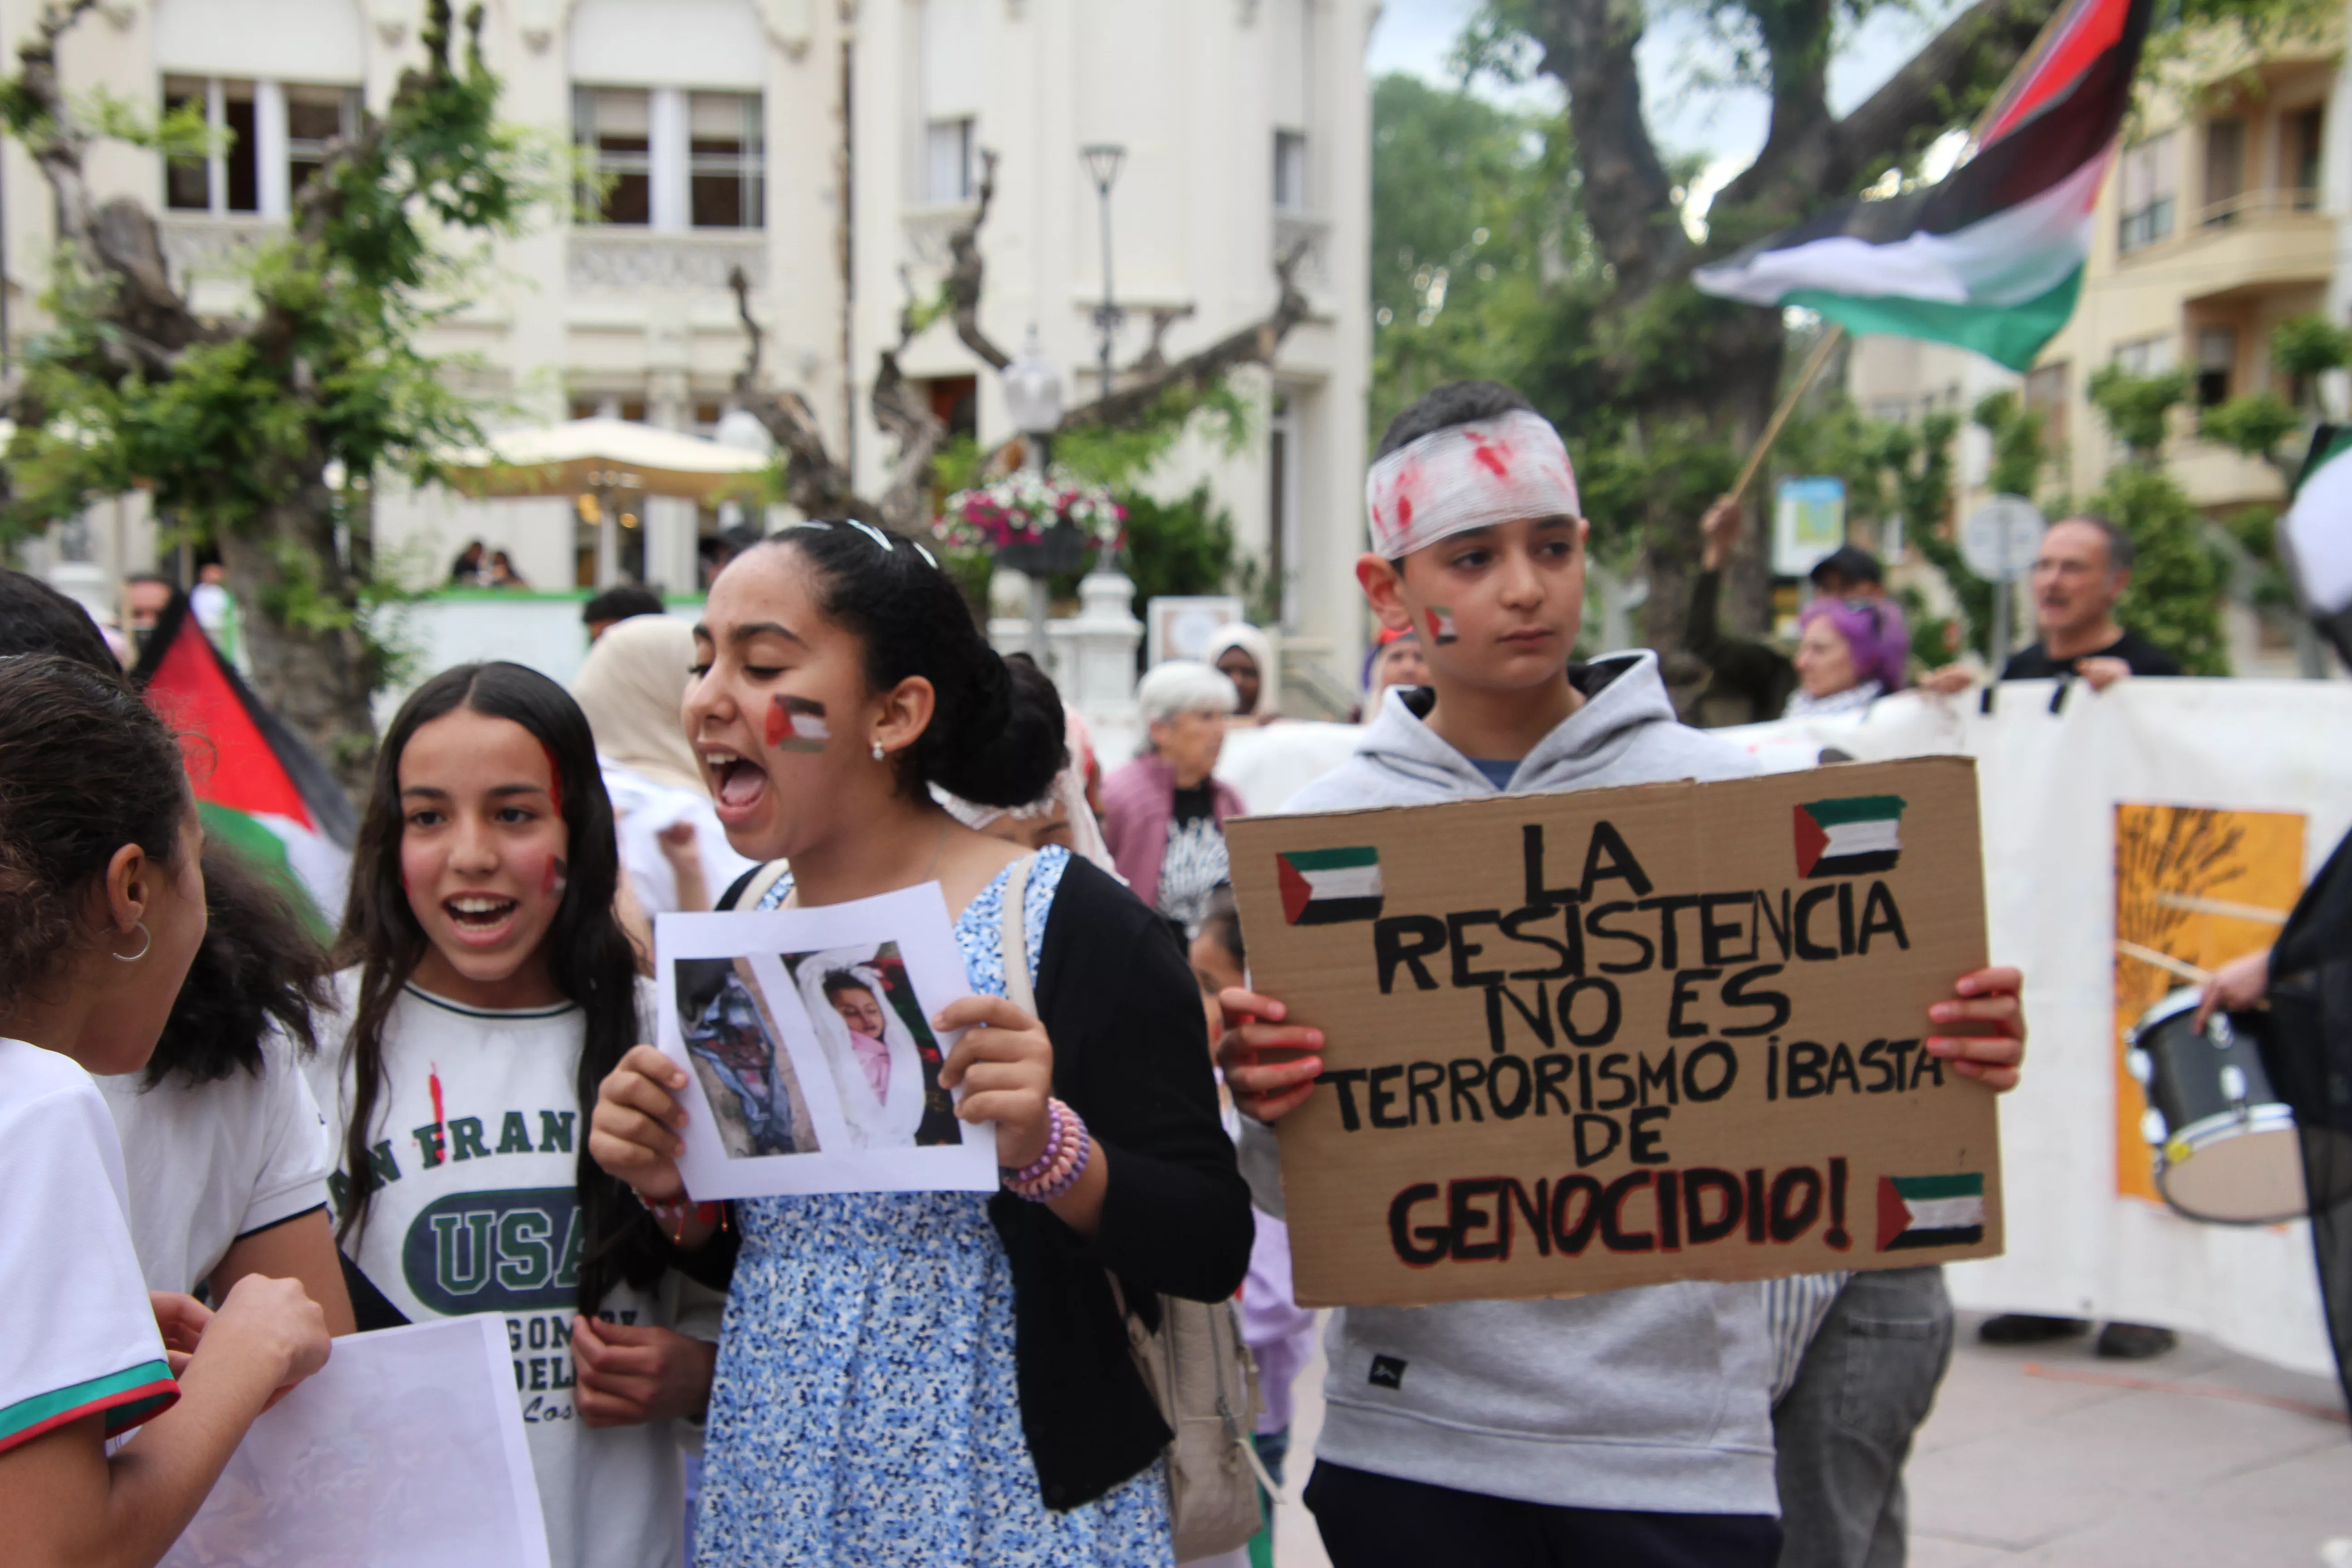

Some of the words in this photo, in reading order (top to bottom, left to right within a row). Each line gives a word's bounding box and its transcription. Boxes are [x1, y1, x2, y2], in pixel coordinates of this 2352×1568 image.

[1523, 822, 1654, 905] LA
[1375, 881, 1910, 994] RESISTENCIA
[1485, 978, 1621, 1053] NO
[1669, 964, 1790, 1038] ES
[1315, 1041, 1738, 1131] TERRORISMO
[1574, 1107, 1670, 1166] DE
[1388, 1157, 1853, 1267] GENOCIDIO!
